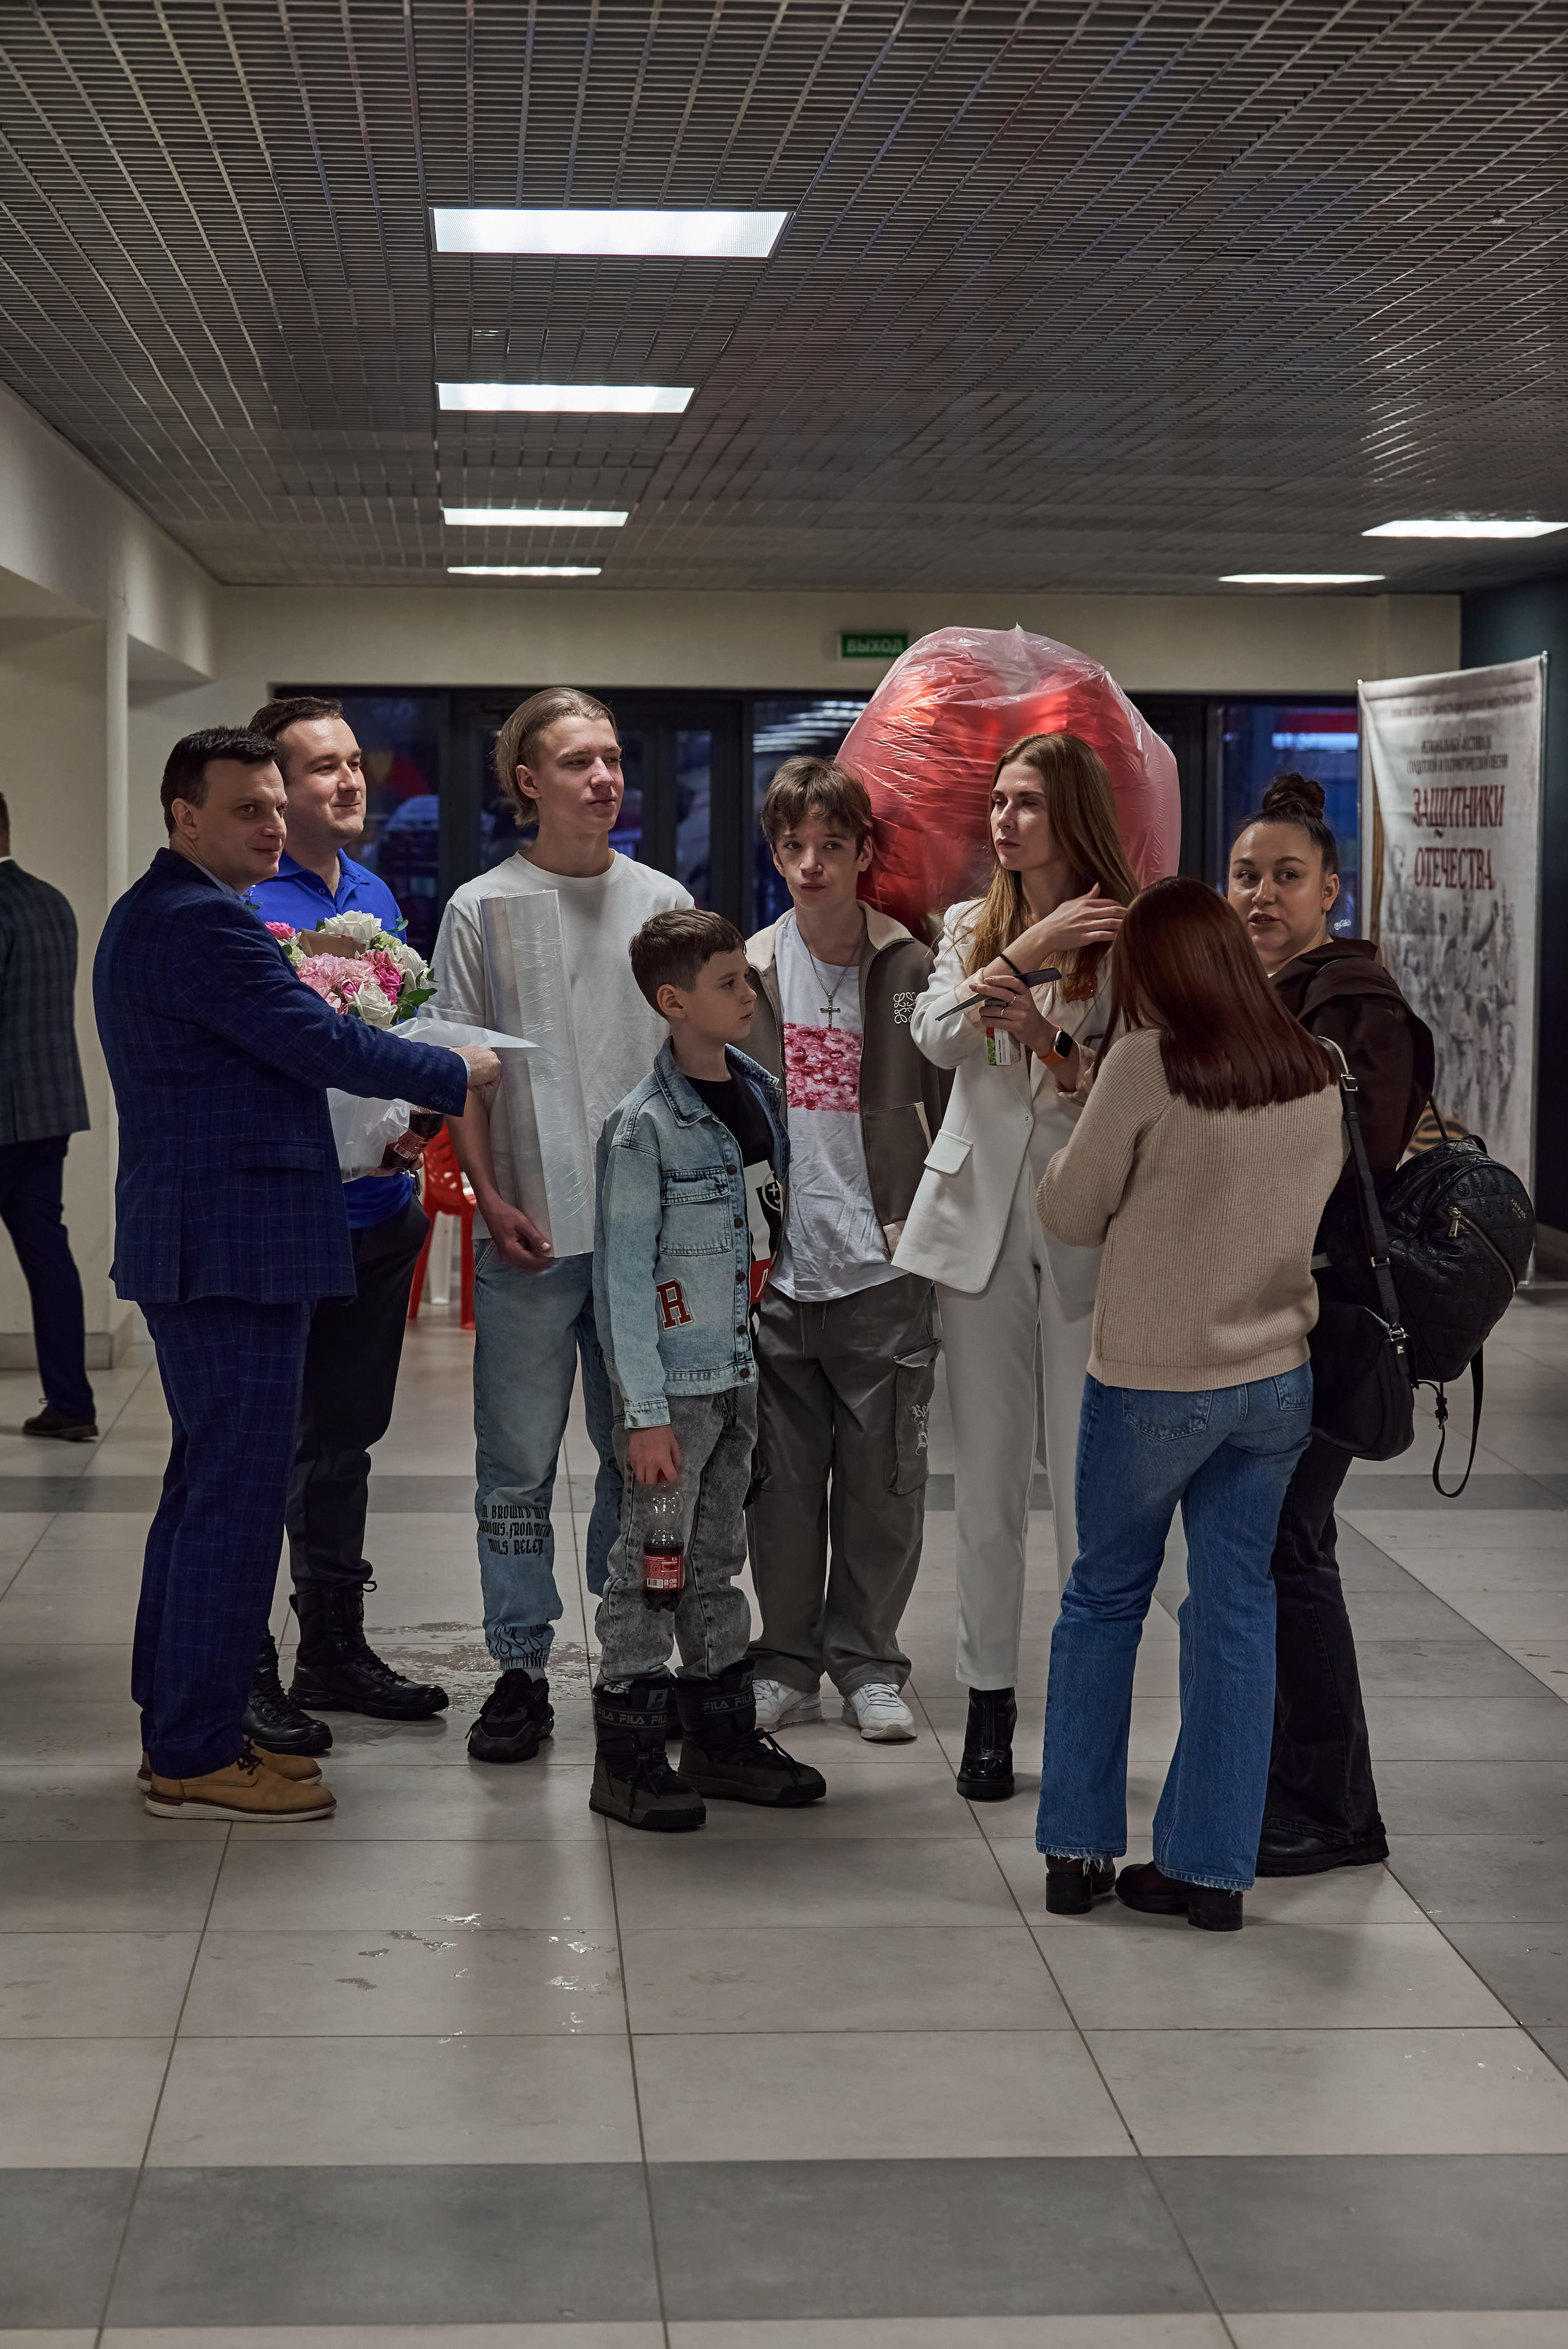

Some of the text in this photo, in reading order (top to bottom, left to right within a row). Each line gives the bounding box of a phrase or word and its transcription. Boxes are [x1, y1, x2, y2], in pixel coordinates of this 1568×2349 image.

[847, 639, 903, 654] ВЫХОД
[1412, 785, 1505, 839] ЗАЩИТНИКИ
[1414, 847, 1496, 891] ОТЕЧЕСТВА
[656, 1280, 695, 1330] R
[597, 1707, 614, 1721] FILA
[619, 1714, 645, 1725] FILA
[703, 1700, 729, 1711] FILA
